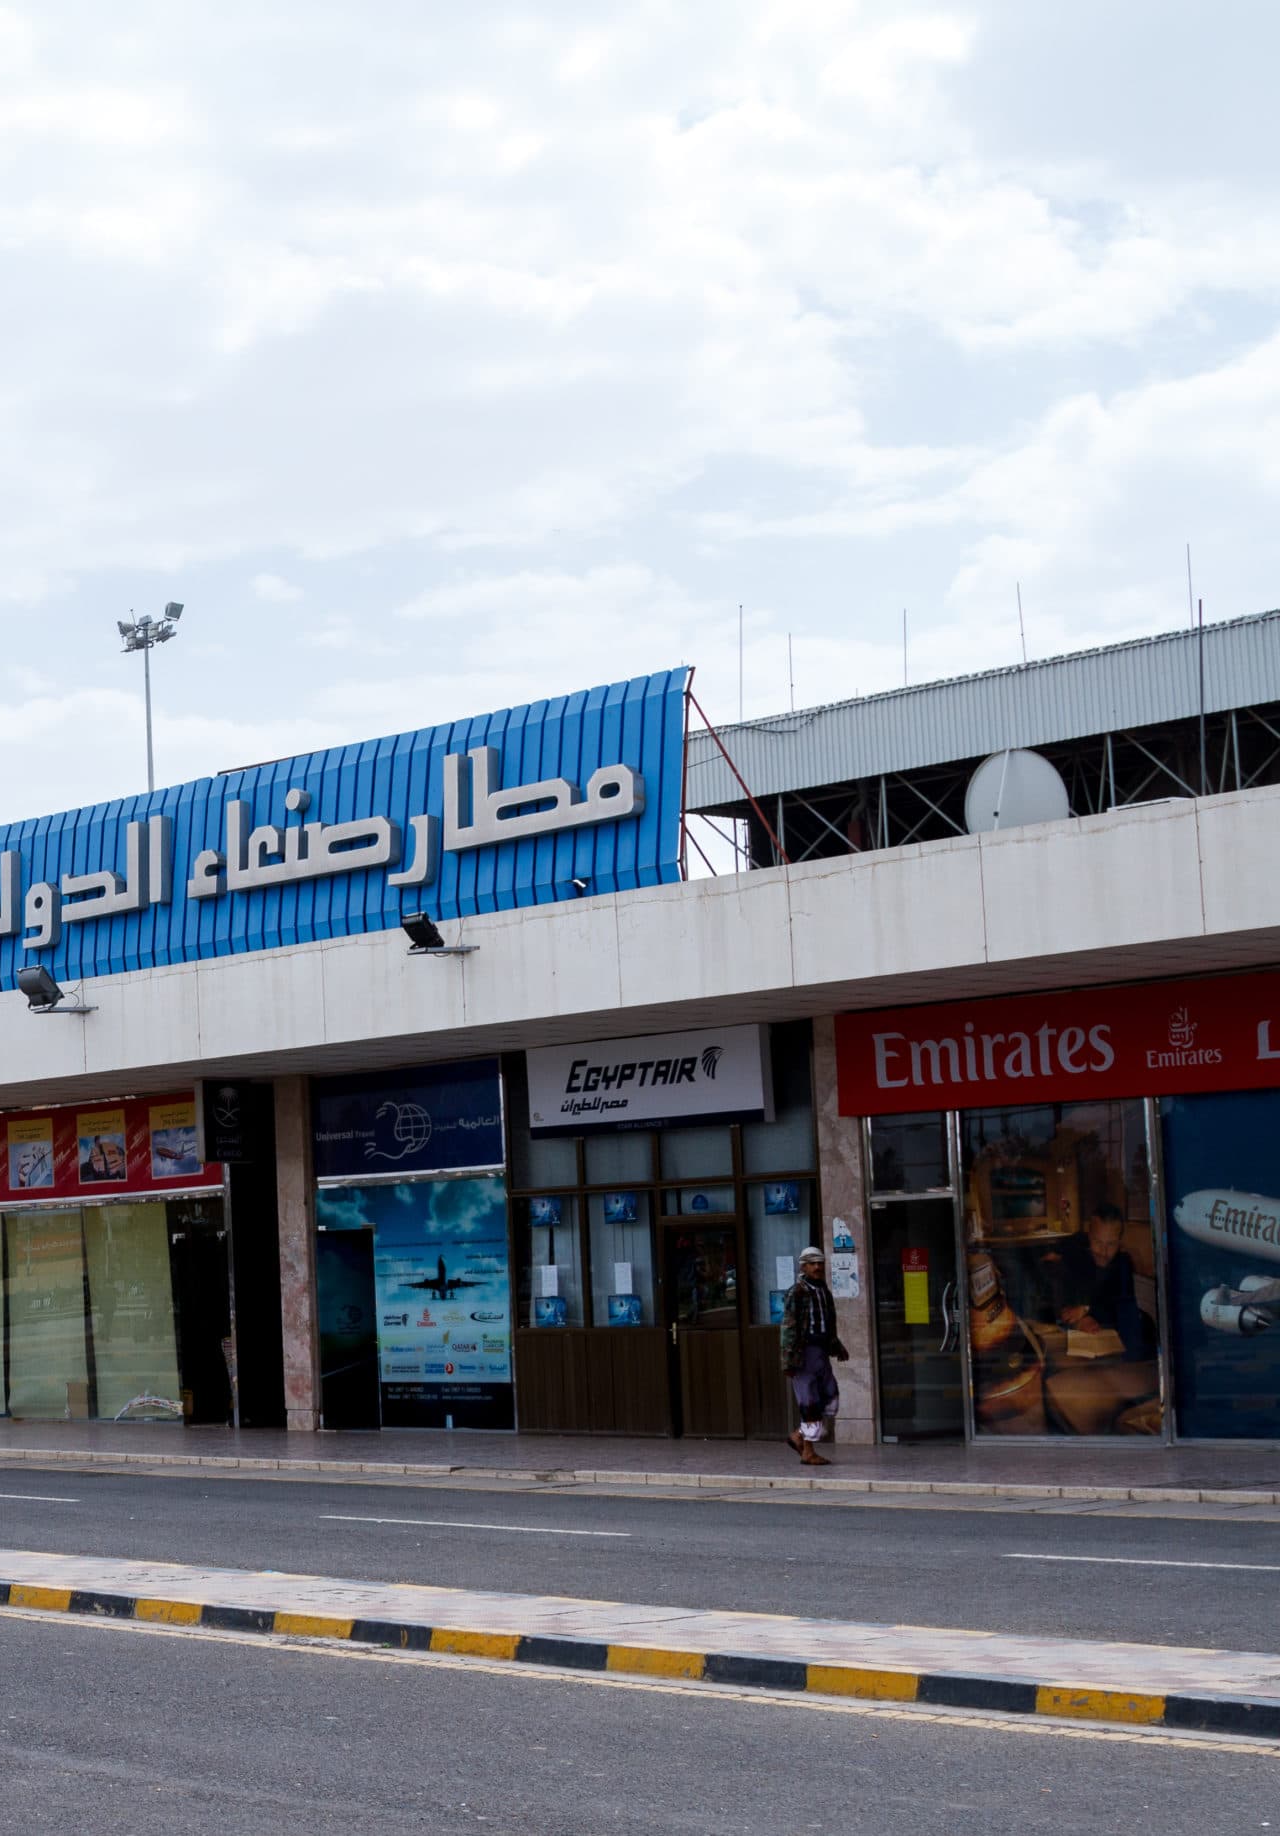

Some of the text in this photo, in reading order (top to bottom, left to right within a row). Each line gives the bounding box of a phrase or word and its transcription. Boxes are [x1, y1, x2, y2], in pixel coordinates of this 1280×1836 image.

[387, 746, 645, 888] مطار
[188, 788, 402, 899] صنعاء
[872, 1021, 1115, 1089] Emirates
[1145, 1047, 1223, 1069] Emirates
[566, 1057, 698, 1093] EGYPTAIR
[560, 1097, 629, 1116] مصر للطيران
[315, 1129, 354, 1142] Universal
